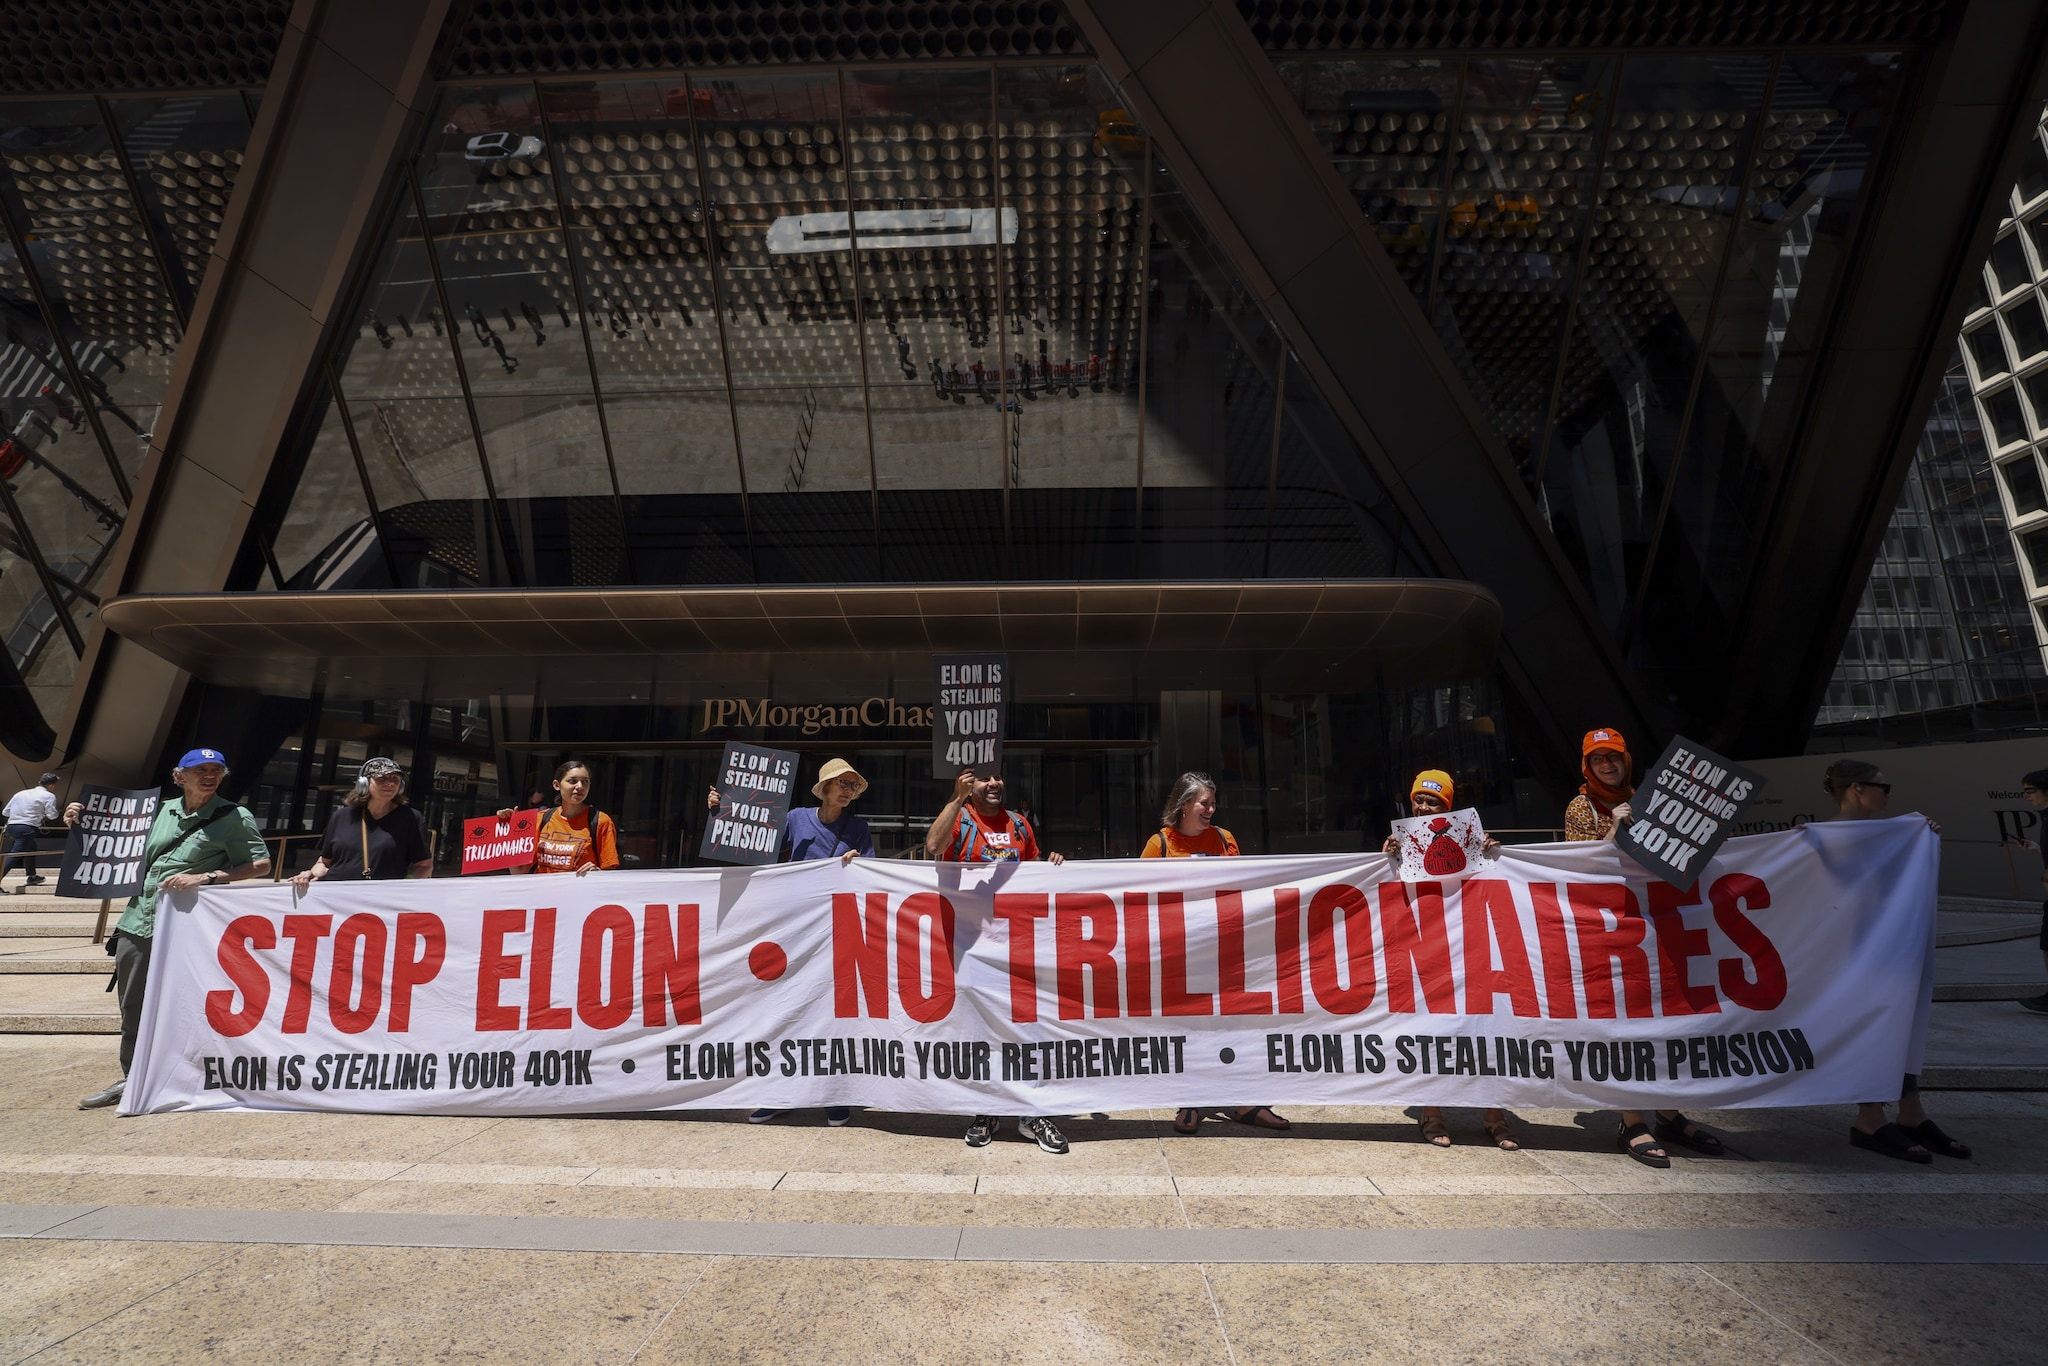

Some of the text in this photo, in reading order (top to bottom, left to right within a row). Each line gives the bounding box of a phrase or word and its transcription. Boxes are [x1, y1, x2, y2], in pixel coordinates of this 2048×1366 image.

[941, 664, 1002, 685] ELON IS
[941, 687, 1001, 706] STEALING
[700, 697, 934, 735] JPMorganChas
[945, 708, 998, 735] YOUR
[730, 751, 790, 776] ELON IS
[945, 739, 996, 765] 401K
[725, 769, 787, 794] STEALING
[1422, 780, 1442, 791] NYCC
[1668, 747, 1753, 802] ELON IS
[86, 793, 156, 815] ELON IS
[1656, 768, 1738, 821] STEALING
[1987, 790, 2026, 800] Welco
[81, 816, 152, 832] STEALING
[731, 801, 770, 822] YOUR
[1645, 789, 1719, 846] YOUR
[495, 822, 510, 837] NO
[711, 819, 777, 853] PENSION
[82, 834, 146, 858] YOUR
[465, 836, 535, 862] TRILLIONAIRES
[555, 843, 575, 851] YORK
[1628, 818, 1699, 872] 401K
[74, 860, 140, 885] 401K
[205, 872, 1787, 1038] STOP ELON NO TRILLIONAIRES
[203, 1028, 1816, 1092] ELON IS STEALING YOUR 401K ELON IS STEALING YOUR RETIREMENT ELON IS STEALING YOUR PENSION
